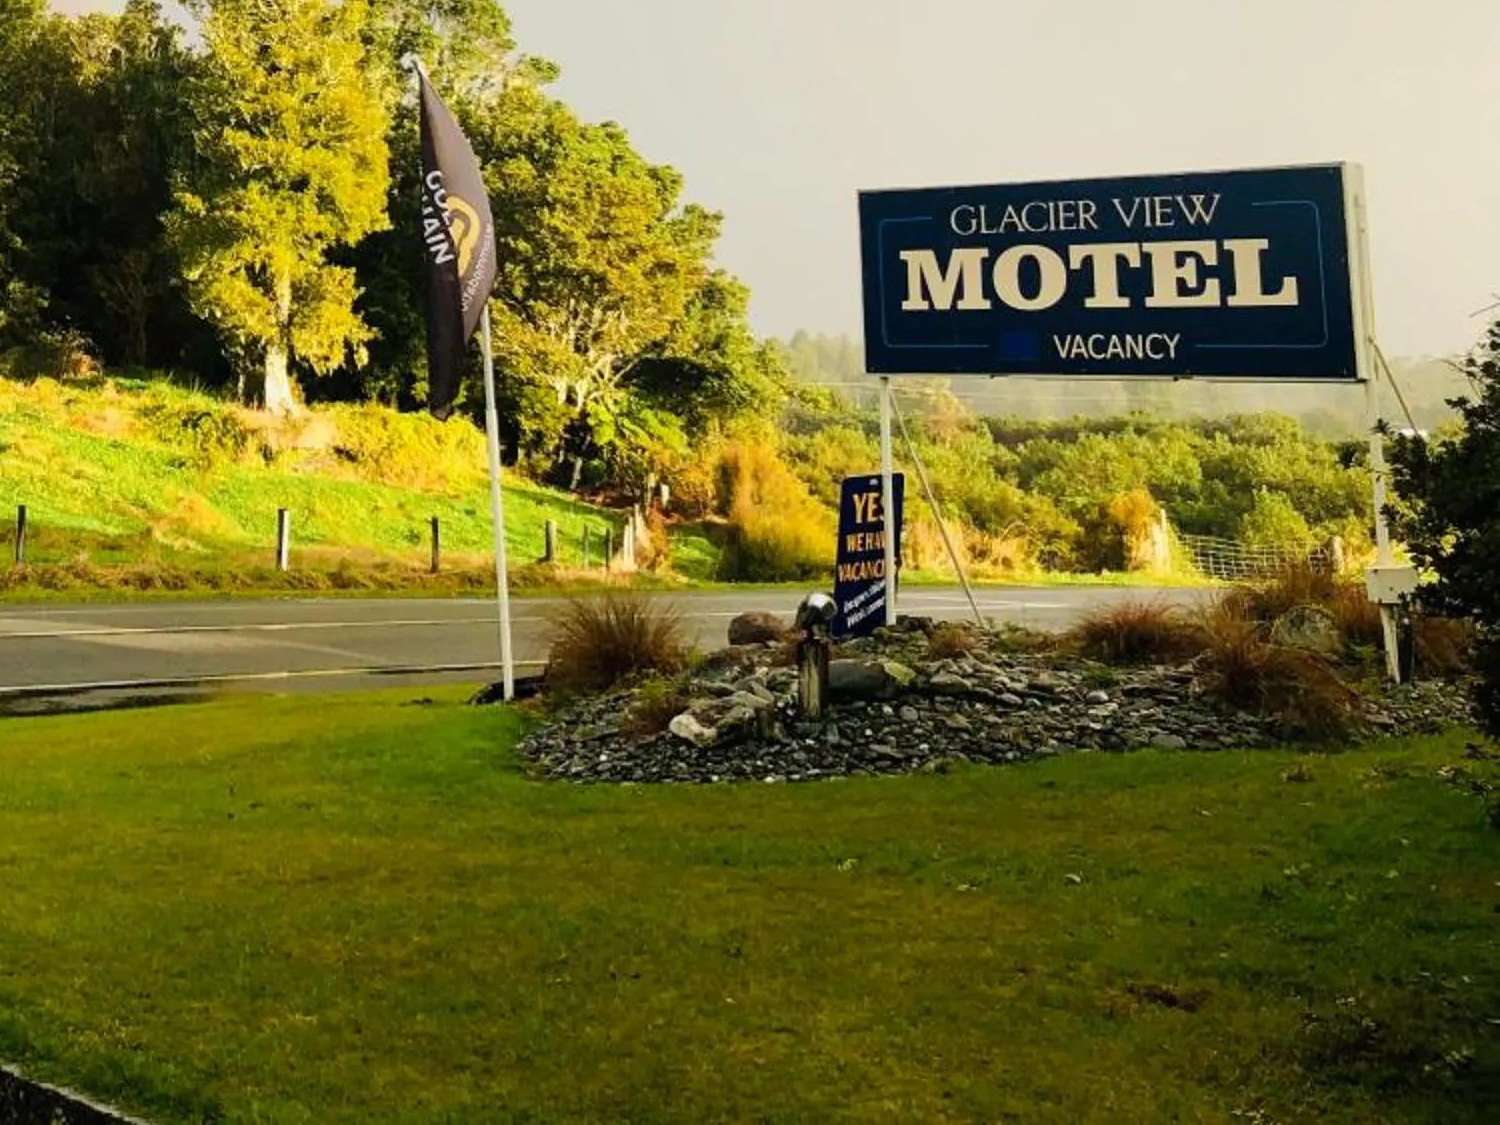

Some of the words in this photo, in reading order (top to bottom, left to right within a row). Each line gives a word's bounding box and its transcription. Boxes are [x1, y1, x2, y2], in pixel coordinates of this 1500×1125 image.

[950, 200, 1099, 236] GLACIER
[1112, 194, 1221, 228] VIEW
[900, 238, 1299, 312] MOTEL
[1053, 333, 1181, 360] VACANCY
[853, 492, 885, 523] YE
[846, 533, 864, 552] WE
[838, 559, 887, 582] VACANC
